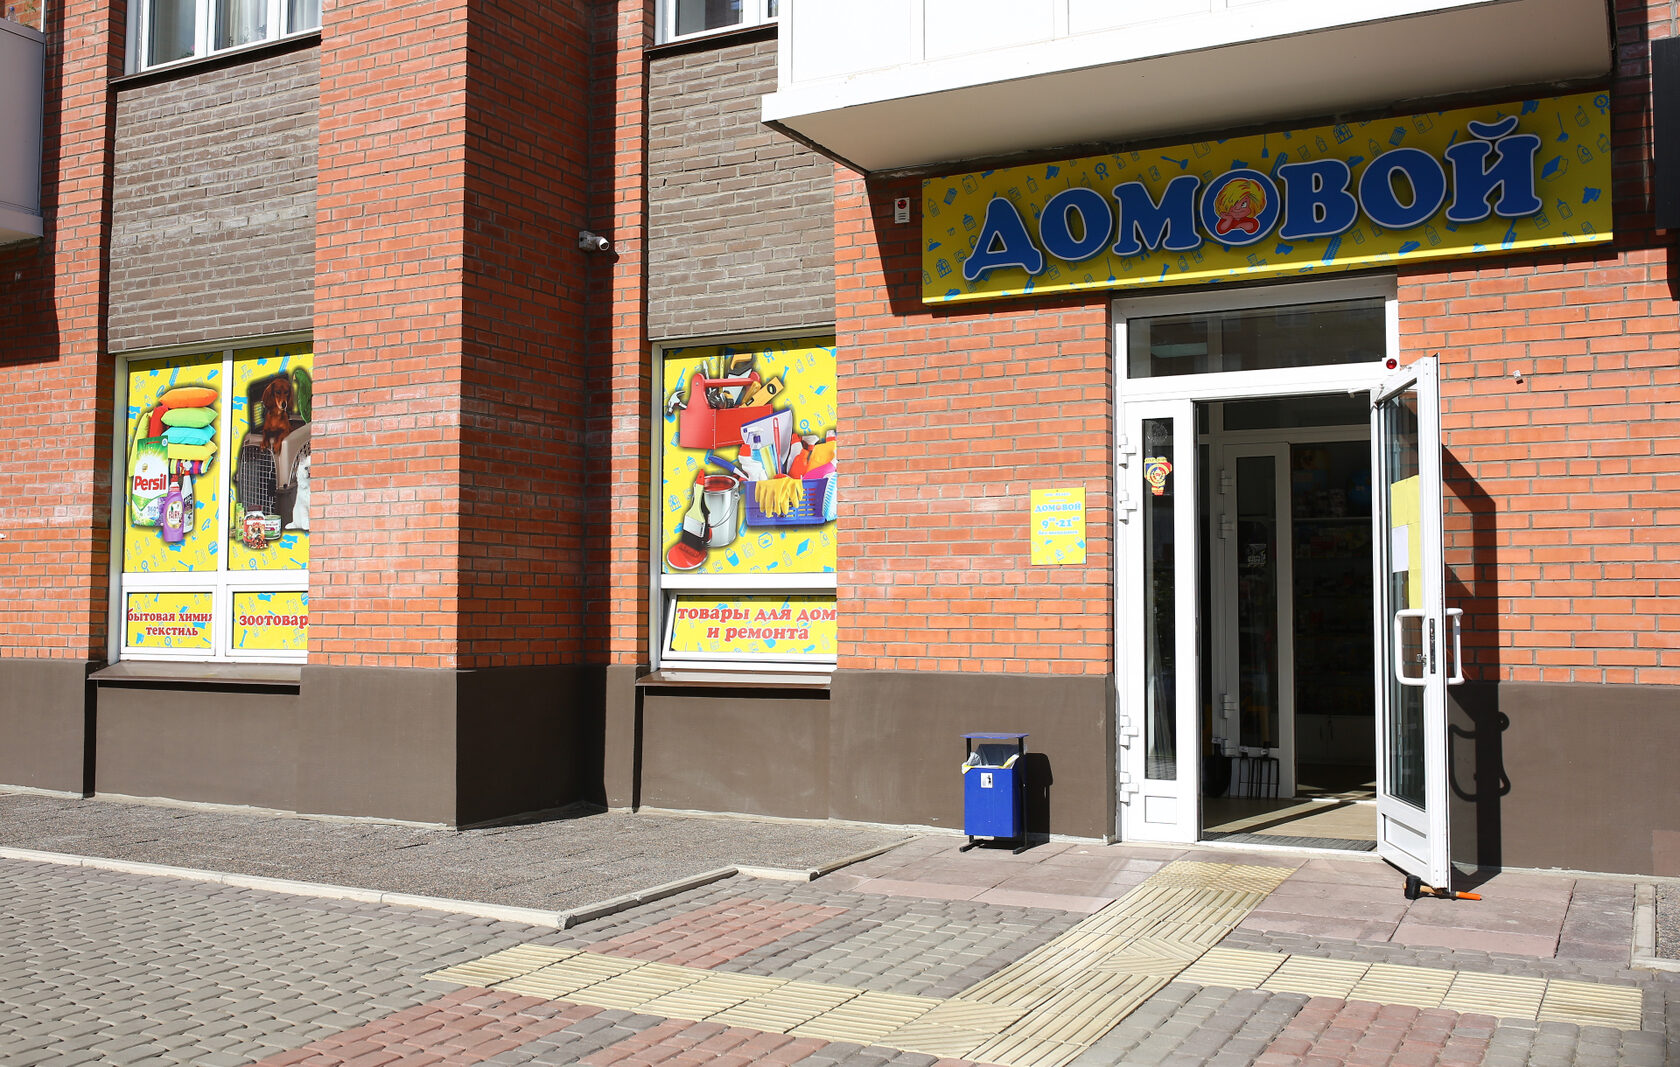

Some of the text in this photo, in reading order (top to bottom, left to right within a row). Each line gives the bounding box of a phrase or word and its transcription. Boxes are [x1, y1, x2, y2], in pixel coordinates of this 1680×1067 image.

[962, 116, 1543, 281] ДОМОВОЙ
[134, 473, 167, 490] Persil
[128, 608, 175, 622] бытовая
[677, 608, 749, 623] товары
[754, 609, 792, 622] для
[146, 627, 198, 636] текстиль
[707, 627, 809, 642] и ремонта
